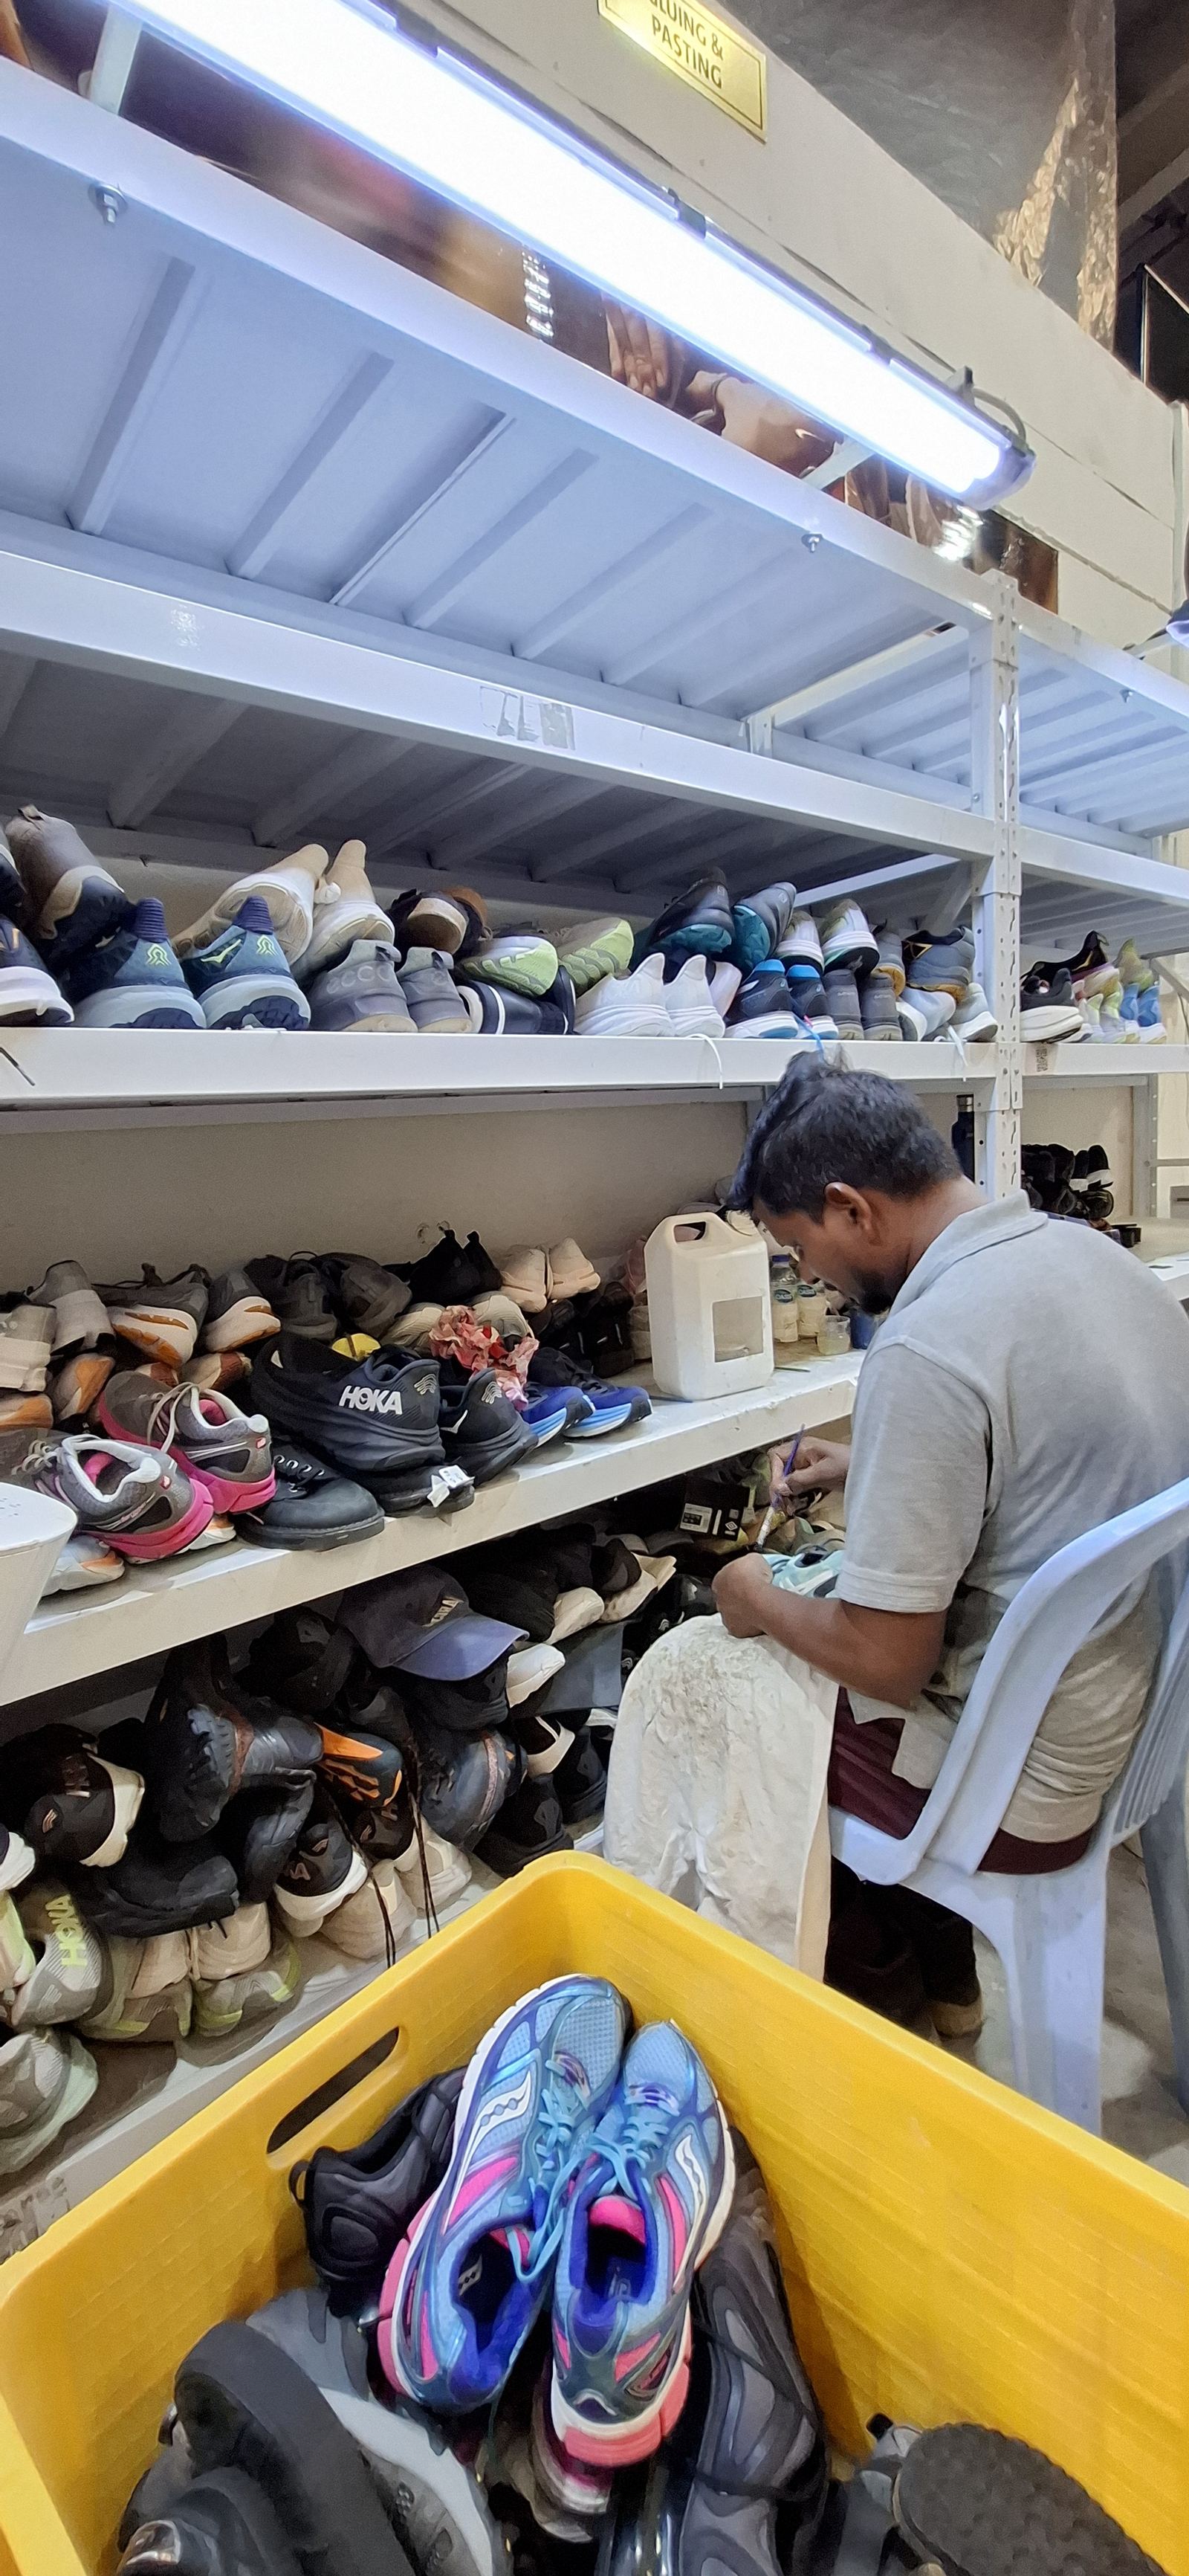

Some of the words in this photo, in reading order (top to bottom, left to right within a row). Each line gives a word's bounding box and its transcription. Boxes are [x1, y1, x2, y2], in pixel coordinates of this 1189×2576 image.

[652, 14, 722, 89] PASTING
[711, 33, 723, 60] &
[339, 1385, 403, 1415] HOKA
[45, 1894, 88, 1966] HOKA
